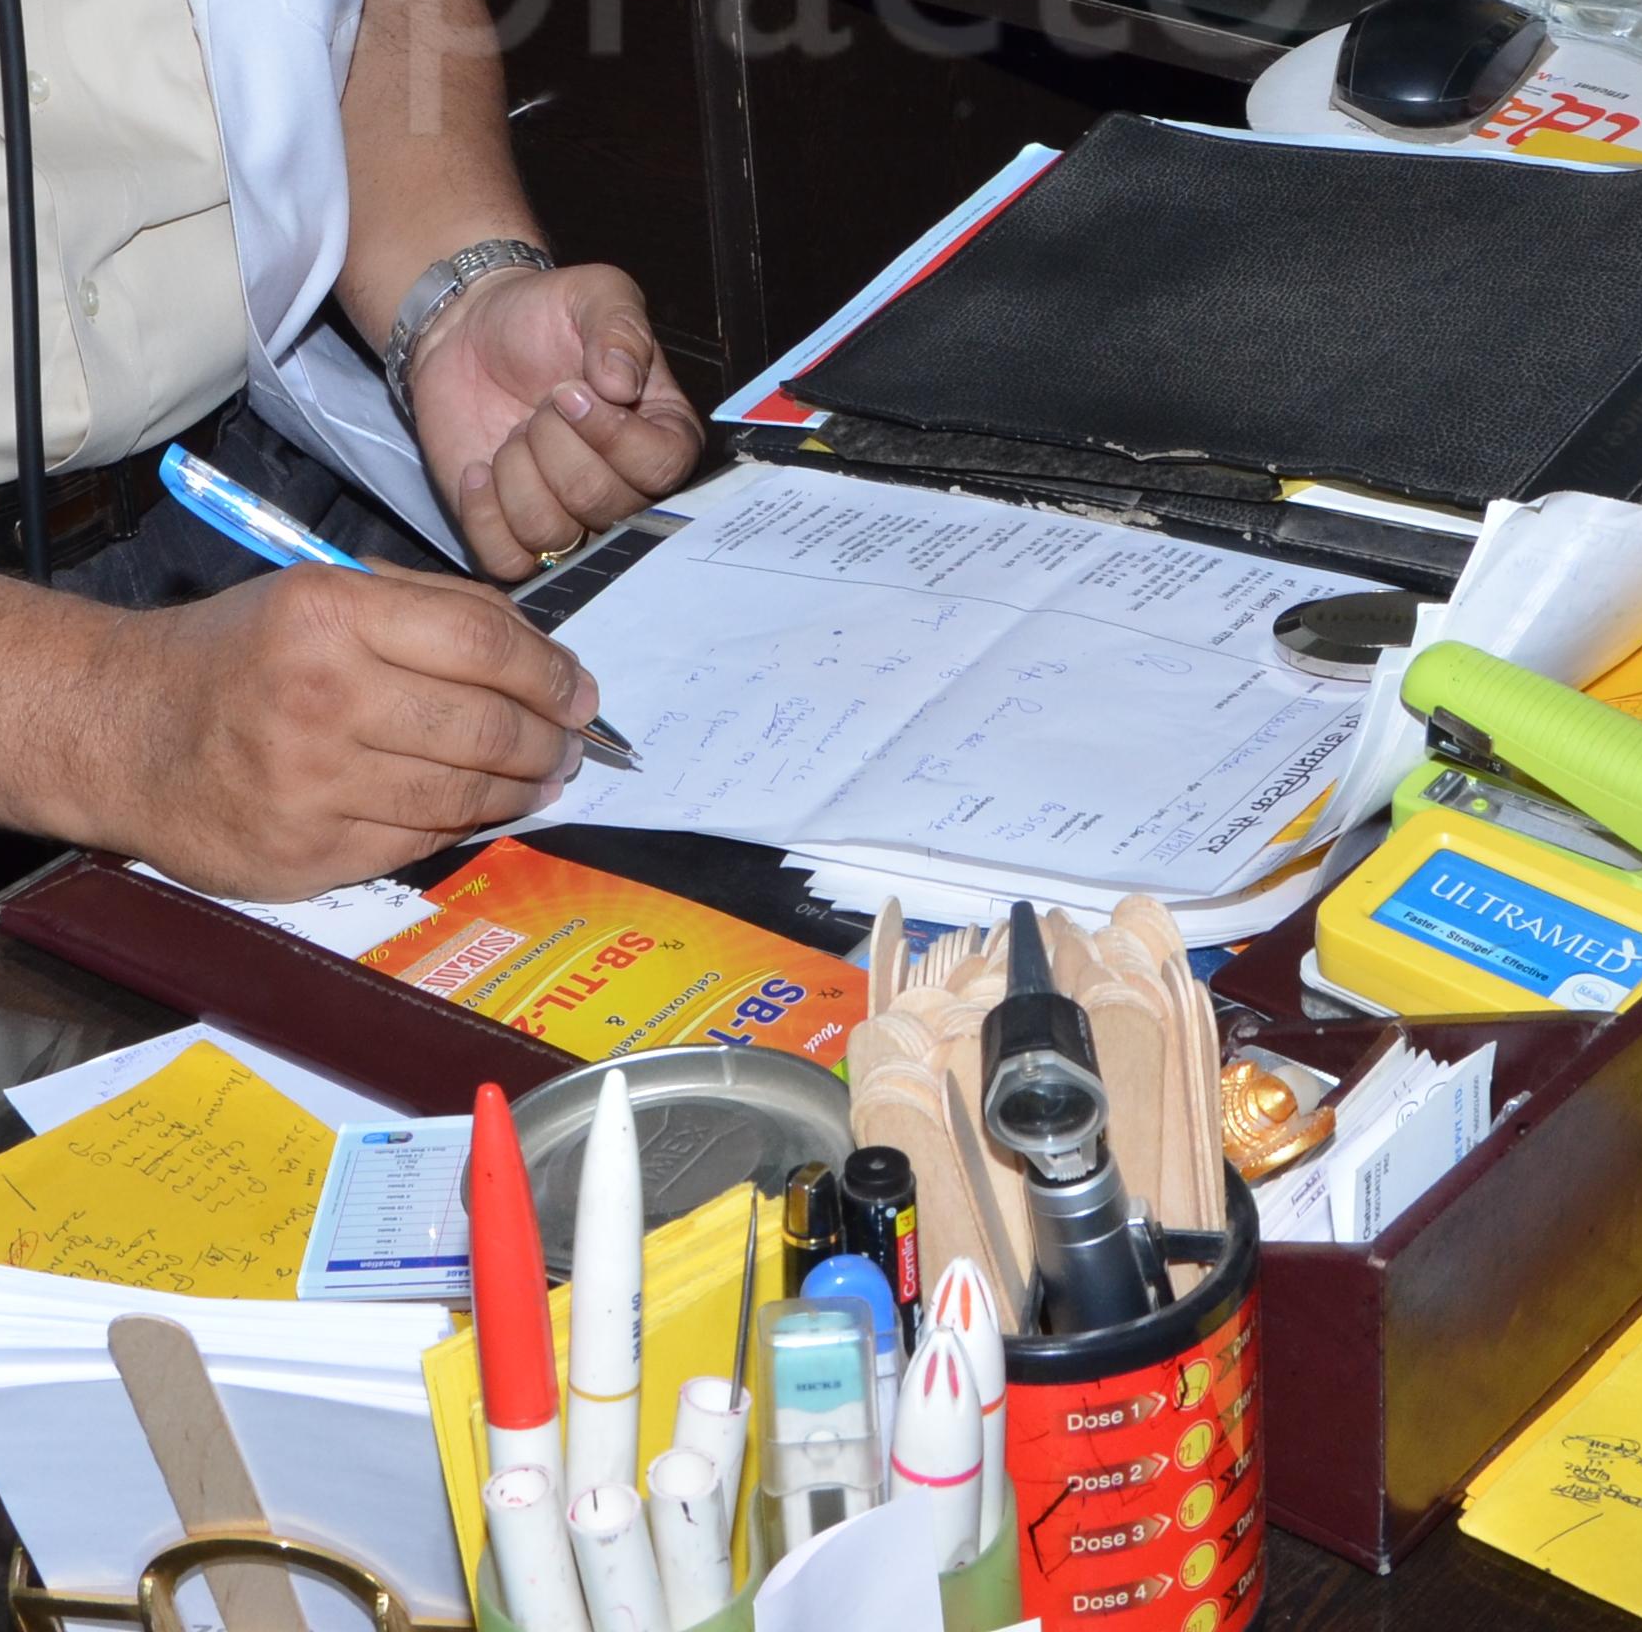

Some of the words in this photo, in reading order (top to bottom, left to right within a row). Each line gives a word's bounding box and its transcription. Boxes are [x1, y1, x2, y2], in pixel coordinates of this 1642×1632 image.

[795, 901, 828, 920] 140
[512, 916, 588, 973] Cefuroxime
[1403, 910, 1438, 934] Faster
[1446, 929, 1495, 959] Stronger
[1500, 953, 1550, 983] Effective
[477, 969, 513, 998] axetil
[647, 971, 723, 1029] Cefuroxime
[604, 1014, 627, 1031] &
[802, 1021, 844, 1055] With
[902, 1233, 916, 1298] Camlin
[1066, 1409, 1125, 1433] Dose
[1130, 1403, 1141, 1419] 1
[1067, 1470, 1125, 1493] Dose
[1130, 1463, 1143, 1481] 2
[1070, 1531, 1127, 1553] Dose
[1132, 1525, 1146, 1542] 3
[1072, 1590, 1129, 1613] Dose
[1134, 1584, 1147, 1600] 4
